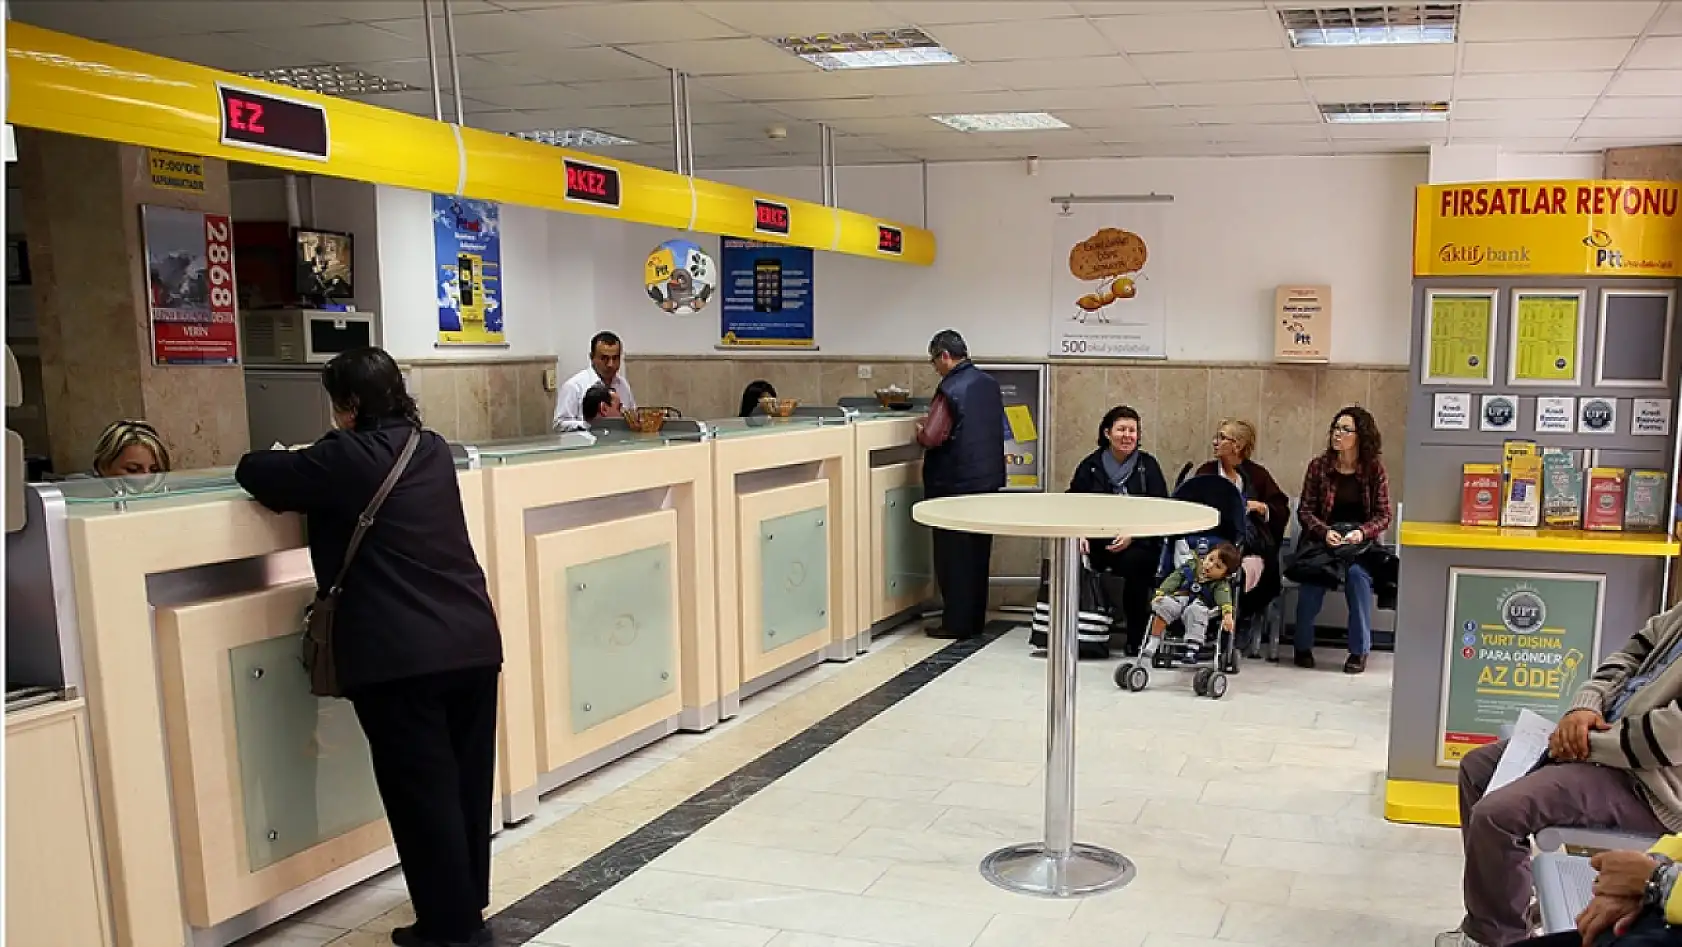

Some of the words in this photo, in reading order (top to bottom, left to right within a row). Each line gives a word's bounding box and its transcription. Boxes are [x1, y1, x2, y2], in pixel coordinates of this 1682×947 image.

[227, 98, 265, 133] EZ
[567, 167, 606, 195] RKEZ
[1440, 187, 1568, 217] FIRSATLAR
[1576, 187, 1679, 217] REYONU
[207, 221, 231, 307] 2868
[1439, 244, 1483, 264] aktif
[1486, 247, 1531, 262] bank
[1596, 249, 1623, 268] Ptt
[1061, 340, 1087, 353] 500
[1510, 605, 1539, 617] UPT
[1481, 633, 1516, 646] YURT
[1518, 635, 1562, 649] DIŞINA
[1478, 649, 1511, 661] PARA
[1514, 649, 1563, 664] GÖNDER
[1478, 665, 1509, 686] AZ
[1514, 663, 1560, 689] ÖDE
